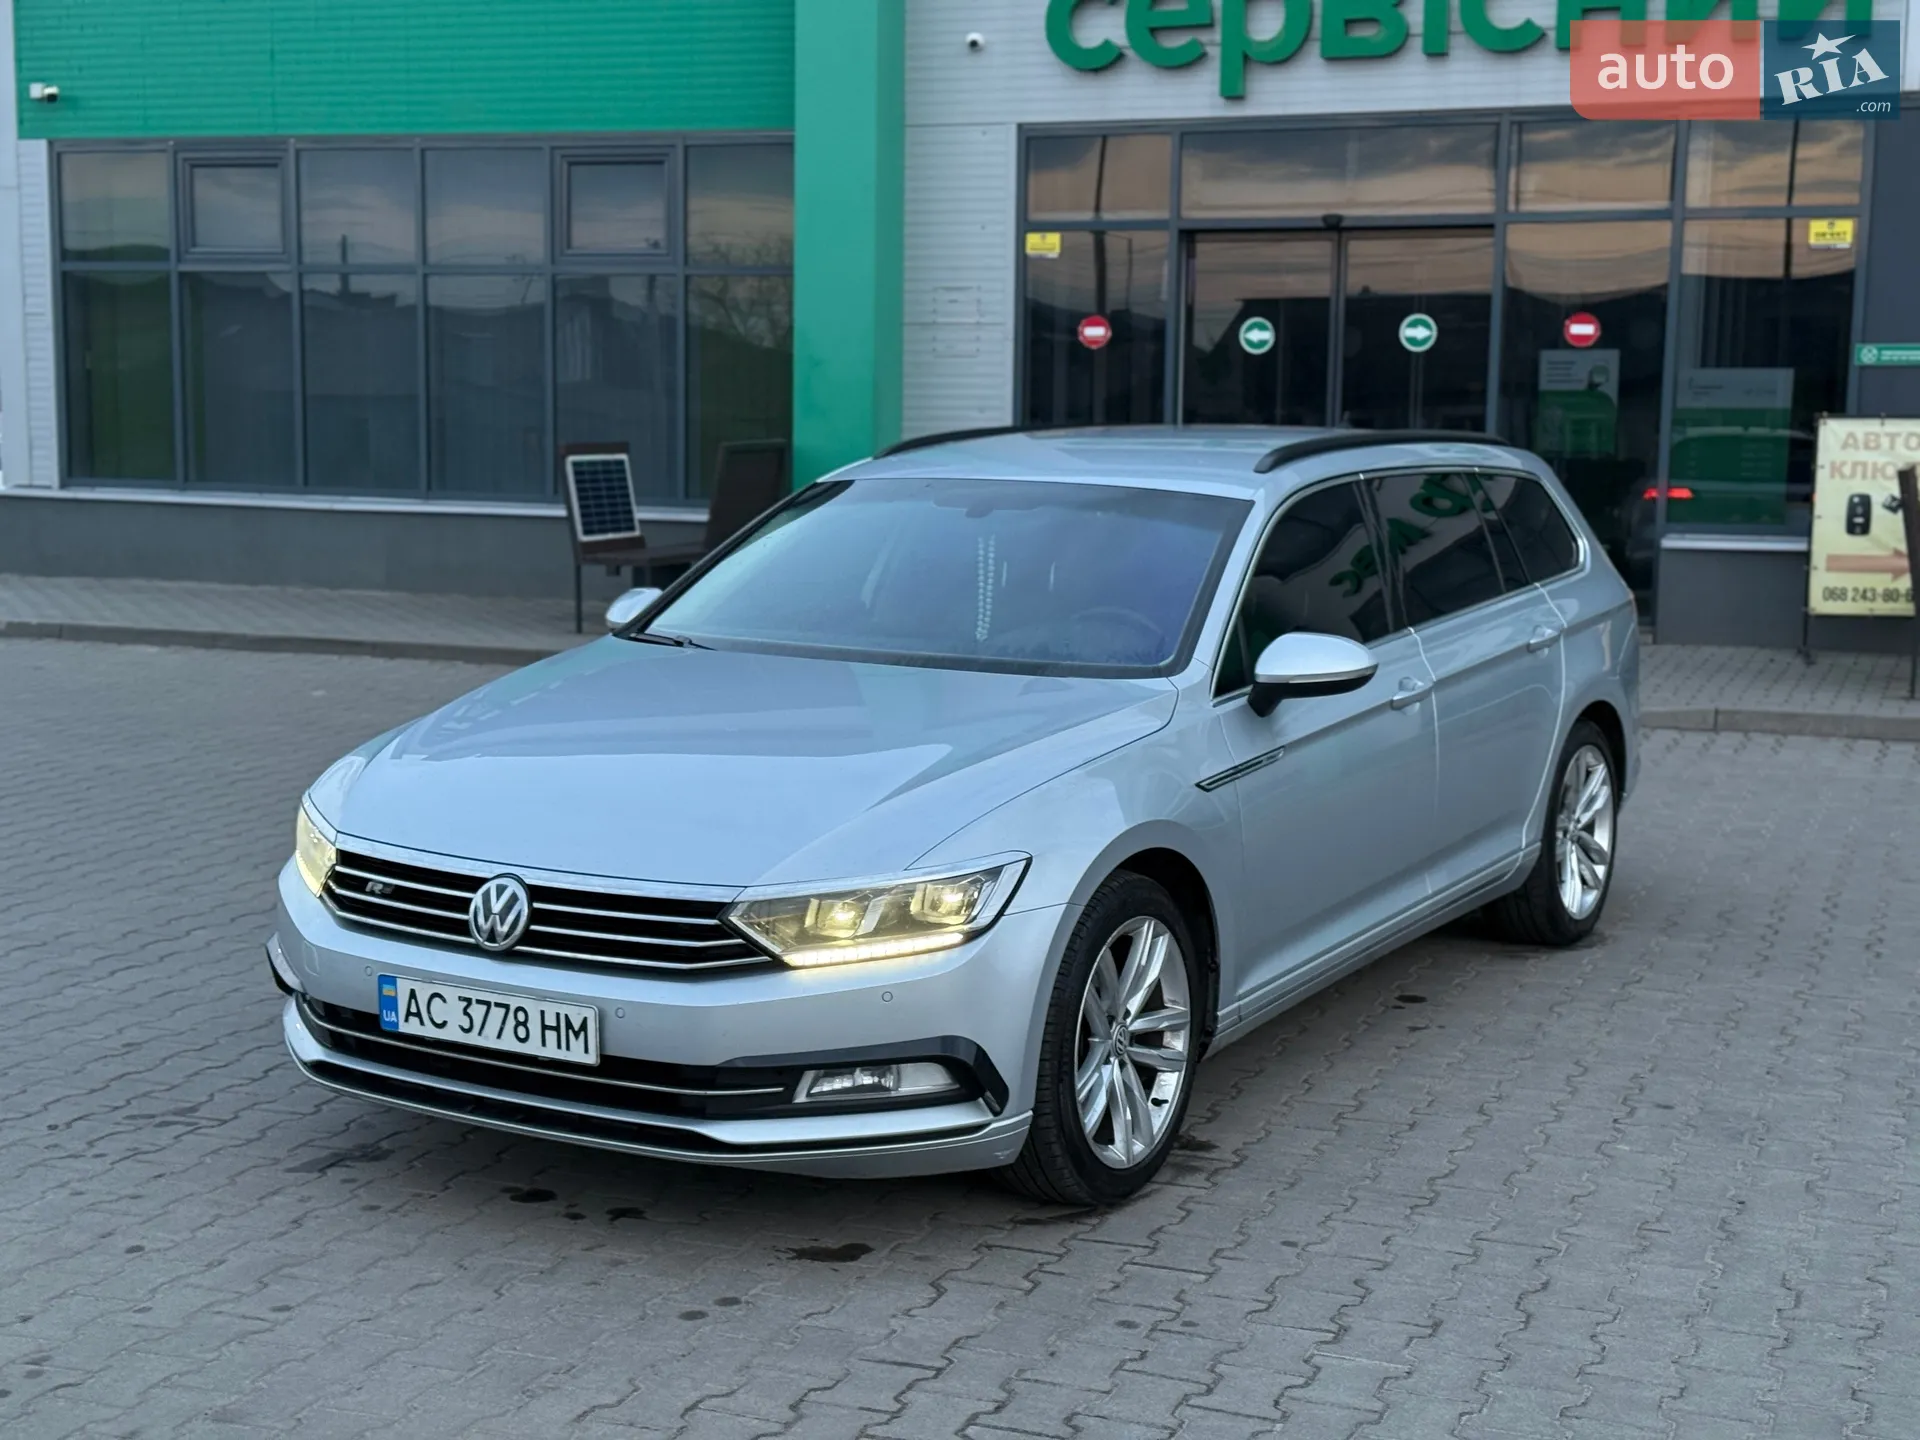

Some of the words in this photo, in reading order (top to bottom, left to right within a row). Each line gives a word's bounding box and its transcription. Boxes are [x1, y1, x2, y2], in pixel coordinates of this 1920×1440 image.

[1840, 431, 1920, 451] АВТО
[1822, 586, 1848, 602] 068
[383, 1011, 397, 1022] UA
[404, 988, 448, 1029] AC
[458, 996, 530, 1043] 3778
[540, 1009, 589, 1054] HM
